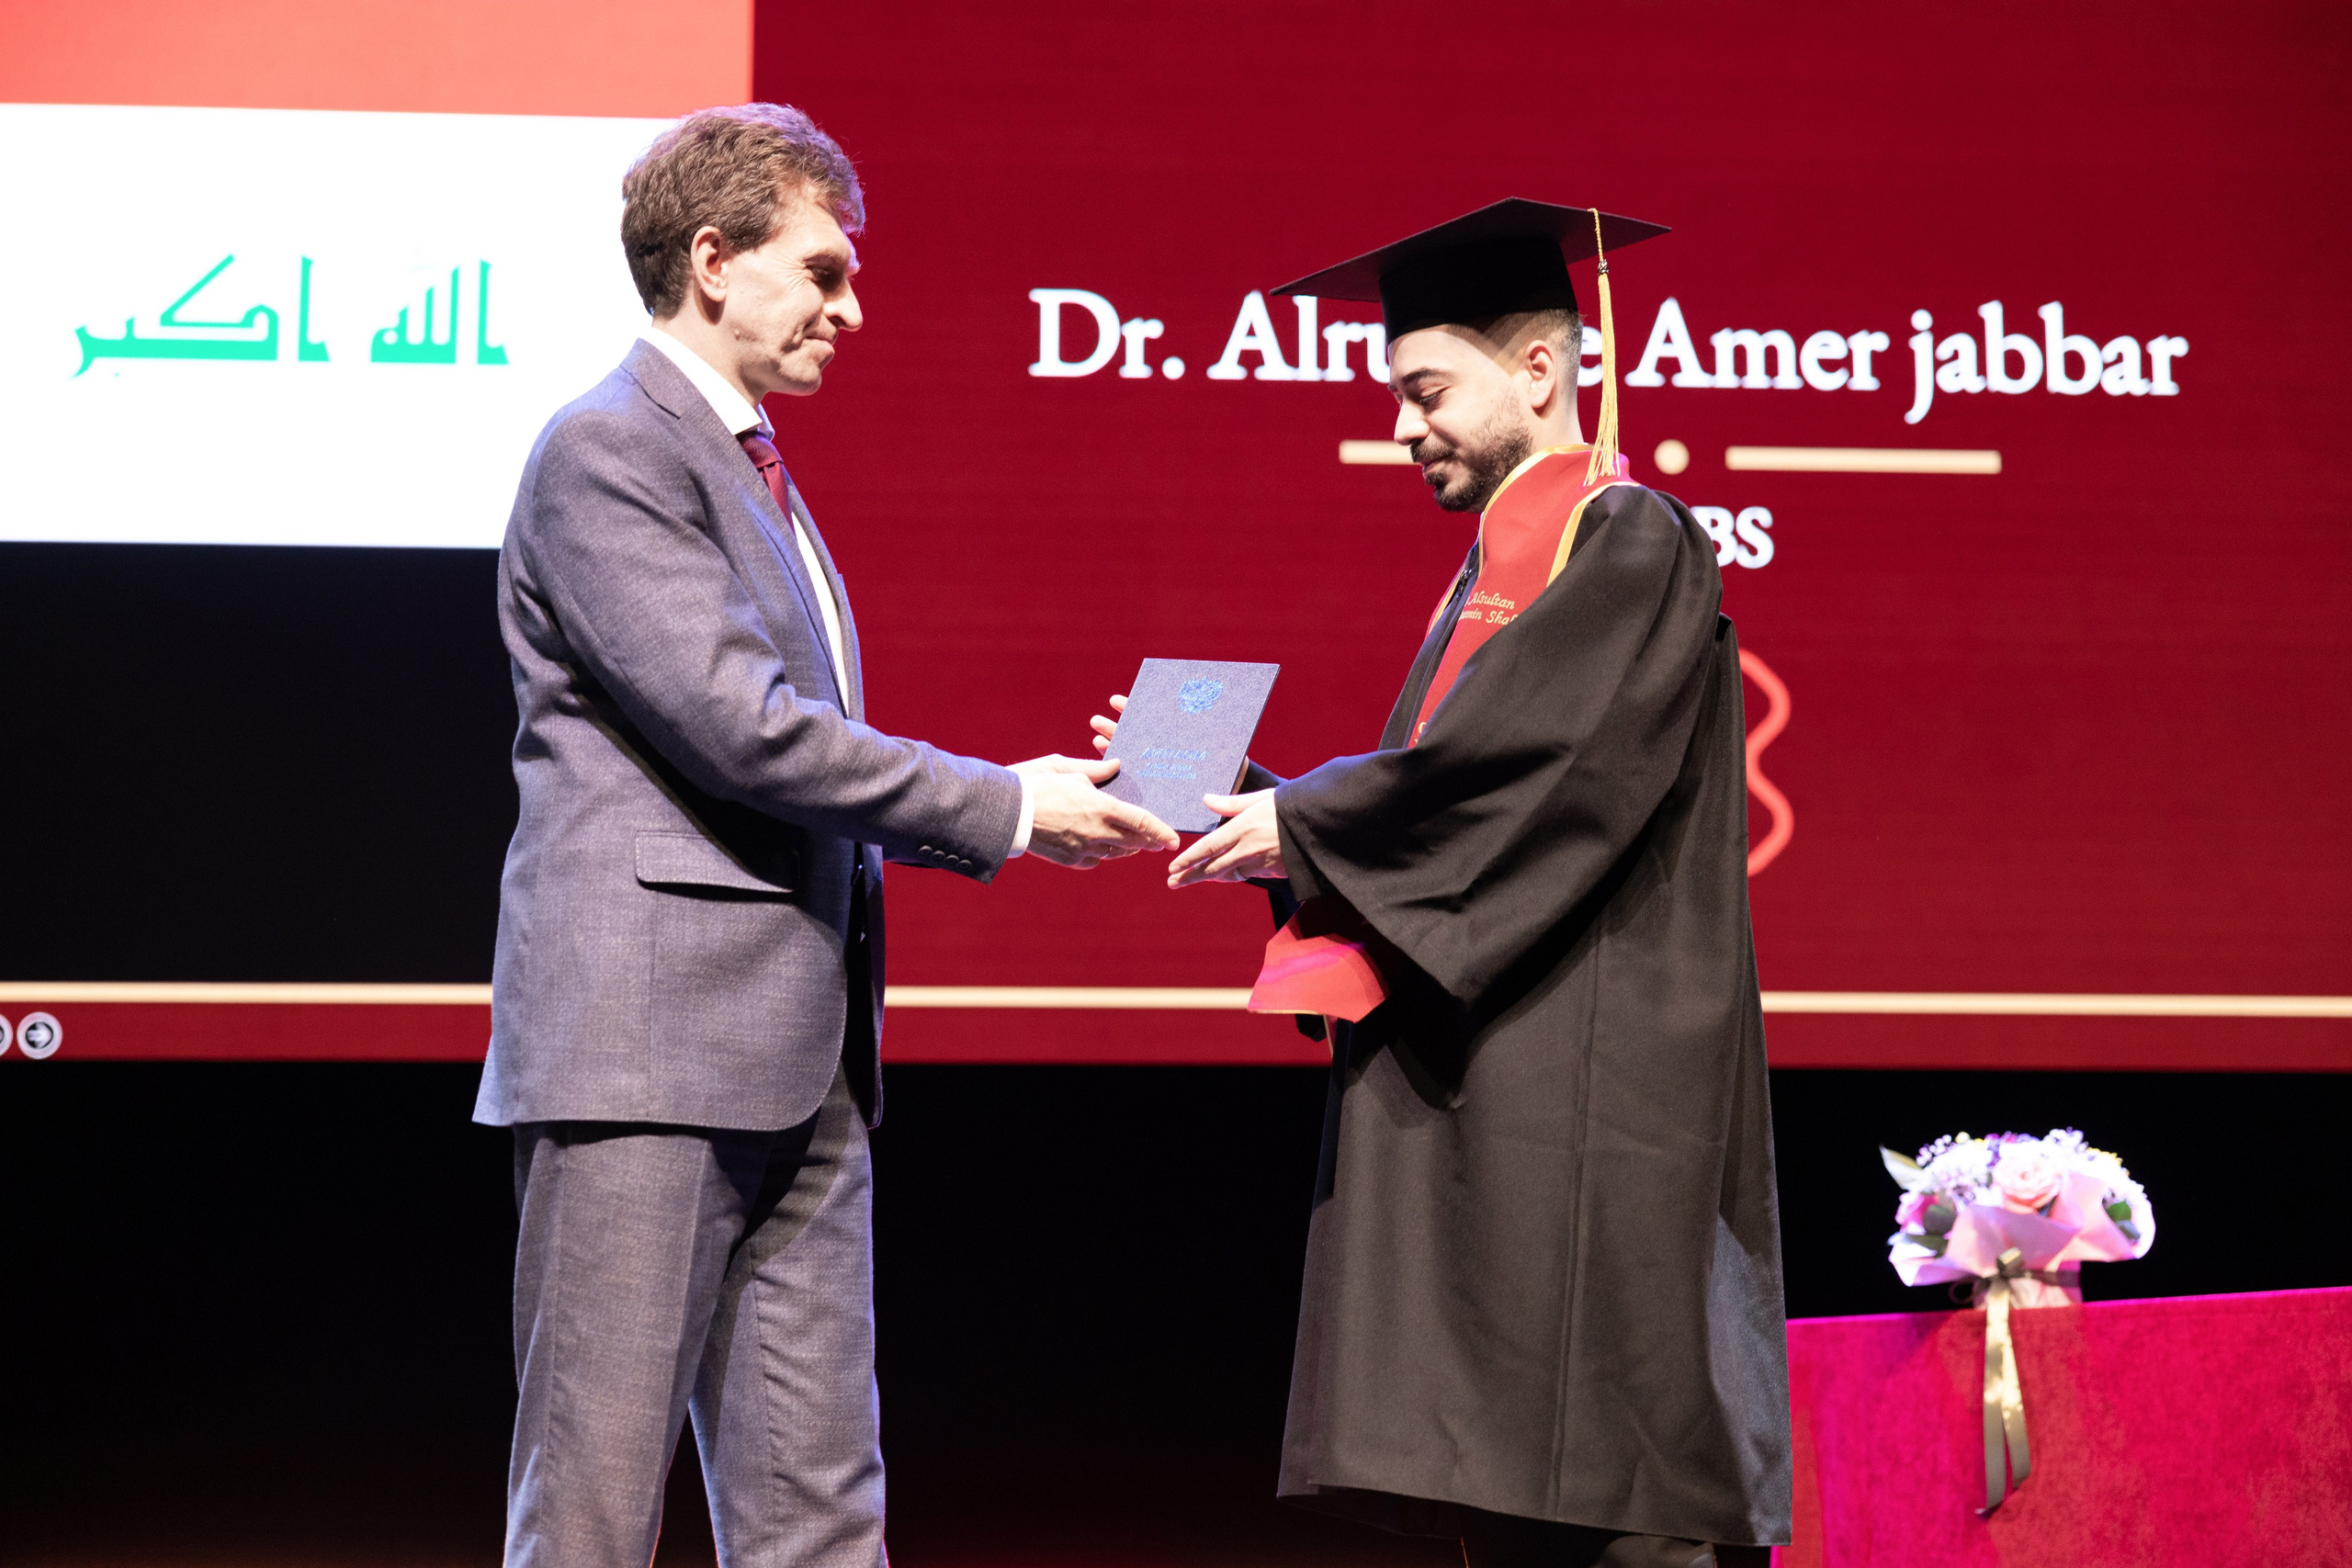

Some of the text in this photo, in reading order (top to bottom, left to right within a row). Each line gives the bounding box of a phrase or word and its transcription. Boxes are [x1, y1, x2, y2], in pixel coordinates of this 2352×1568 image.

[1027, 288, 1186, 380] Dr.
[1623, 297, 1891, 392] Amer
[1904, 299, 2189, 425] jabbar
[1690, 505, 1775, 570] BS
